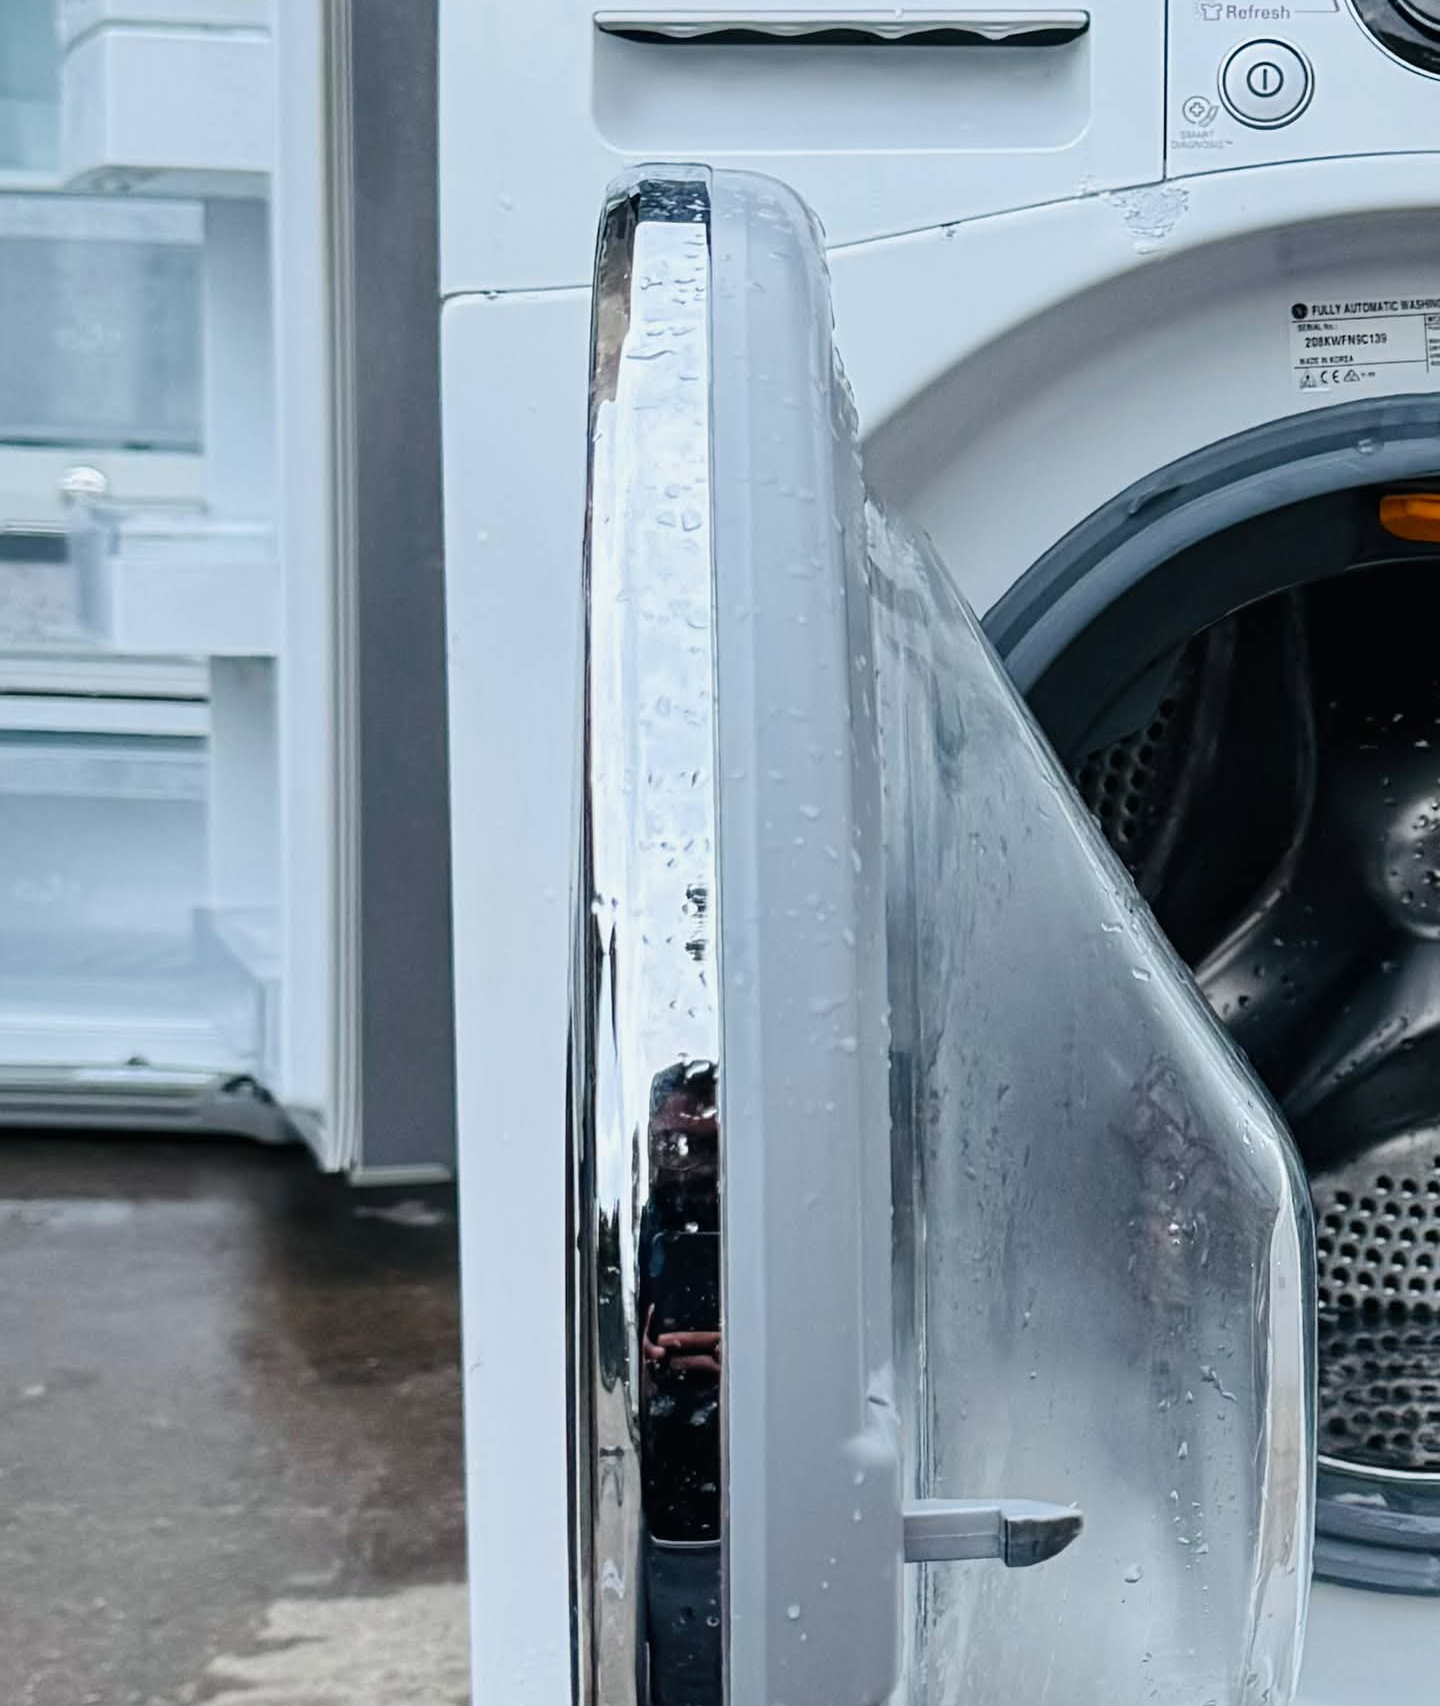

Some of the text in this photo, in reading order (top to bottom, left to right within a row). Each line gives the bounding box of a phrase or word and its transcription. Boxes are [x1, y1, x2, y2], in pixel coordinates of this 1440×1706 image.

[1225, 5, 1291, 21] Refresh
[1311, 304, 1341, 316] FULLY
[1344, 300, 1399, 314] AUTOMATIC
